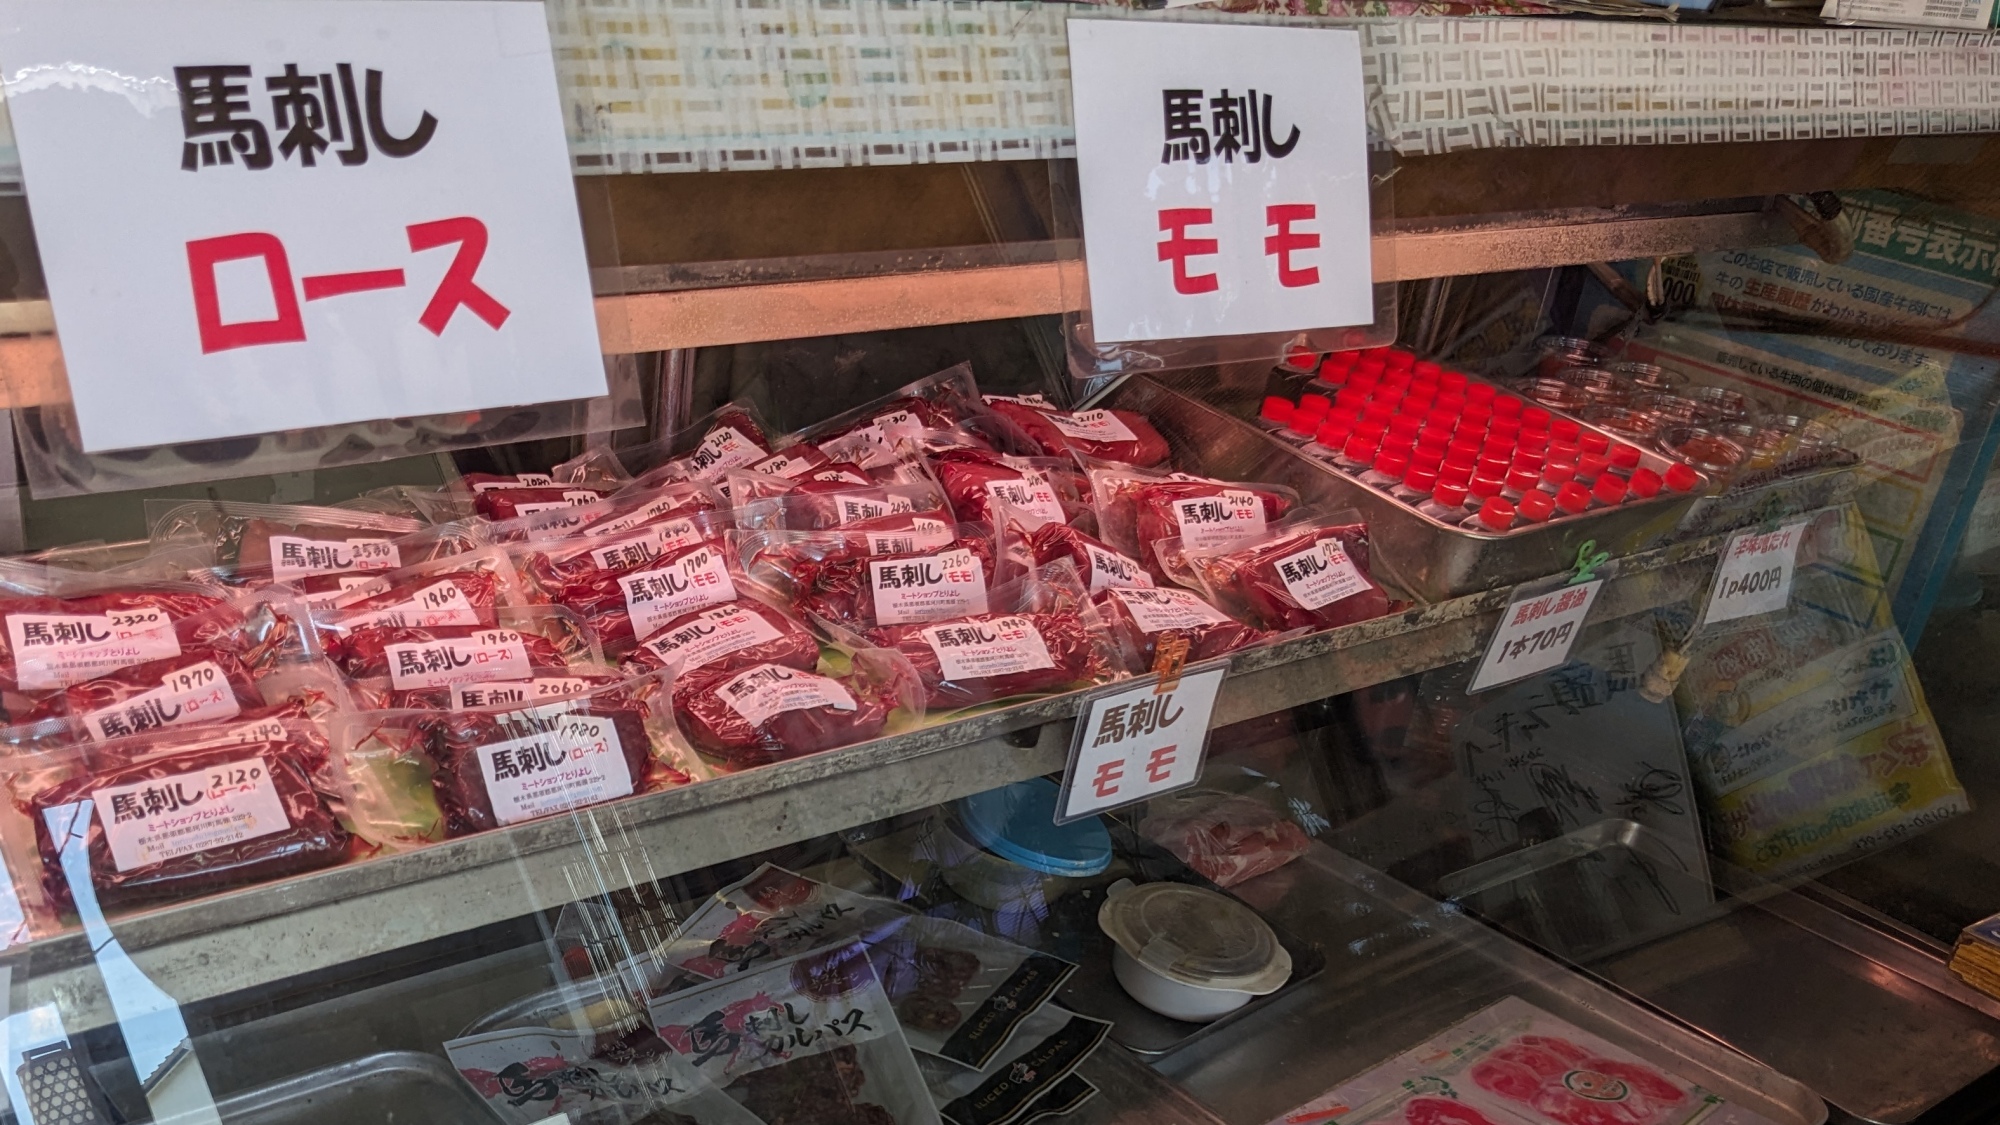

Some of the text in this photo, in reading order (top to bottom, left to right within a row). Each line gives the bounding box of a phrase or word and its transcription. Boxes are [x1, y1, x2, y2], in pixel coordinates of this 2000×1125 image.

[174, 62, 438, 172] 馬刺し
[1161, 88, 1301, 165] 馬刺し
[186, 216, 511, 354] ロース
[993, 485, 1034, 505] 馬刺し
[1181, 501, 1233, 524] 馬刺し
[281, 543, 353, 569] 馬刺し
[603, 540, 661, 570] 馬刺し
[942, 556, 969, 570] 2260
[1094, 552, 1132, 582] 馬刺し
[1281, 555, 1327, 585] 馬刺し
[628, 573, 688, 604] 馬刺し
[879, 563, 975, 589] 馬刺し (モモ)
[1718, 566, 1782, 600] 1p400円
[423, 587, 456, 610] 1960
[901, 590, 960, 599] ミートショップとりよし
[1119, 590, 1170, 605] 馬刺し
[1510, 587, 1588, 627] 馬刺し醤油
[23, 622, 111, 646] 馬刺し
[112, 613, 158, 627] 2320
[999, 619, 1026, 632] 1940
[480, 632, 518, 645] 1960
[652, 625, 716, 655] 馬刺し
[934, 626, 996, 648] 馬刺し
[1496, 621, 1575, 665] 1本70円
[400, 646, 512, 677] 馬刺し (ロース)
[172, 668, 214, 692] 1970
[539, 682, 582, 694] 2060
[727, 668, 792, 701] 馬刺し
[98, 699, 181, 738] 馬刺し
[1092, 694, 1184, 748] 馬刺し
[491, 743, 566, 782] 馬刺し
[212, 768, 261, 788] 2120
[522, 767, 592, 791] ミートショップとりよし
[110, 783, 203, 824] 馬刺し
[148, 805, 235, 832] ミートショップとりよし
[1009, 968, 1039, 997] CALPAS
[759, 1008, 872, 1056] カルパス
[968, 1010, 996, 1040] SLICED
[1030, 1038, 1069, 1069] CALPAS
